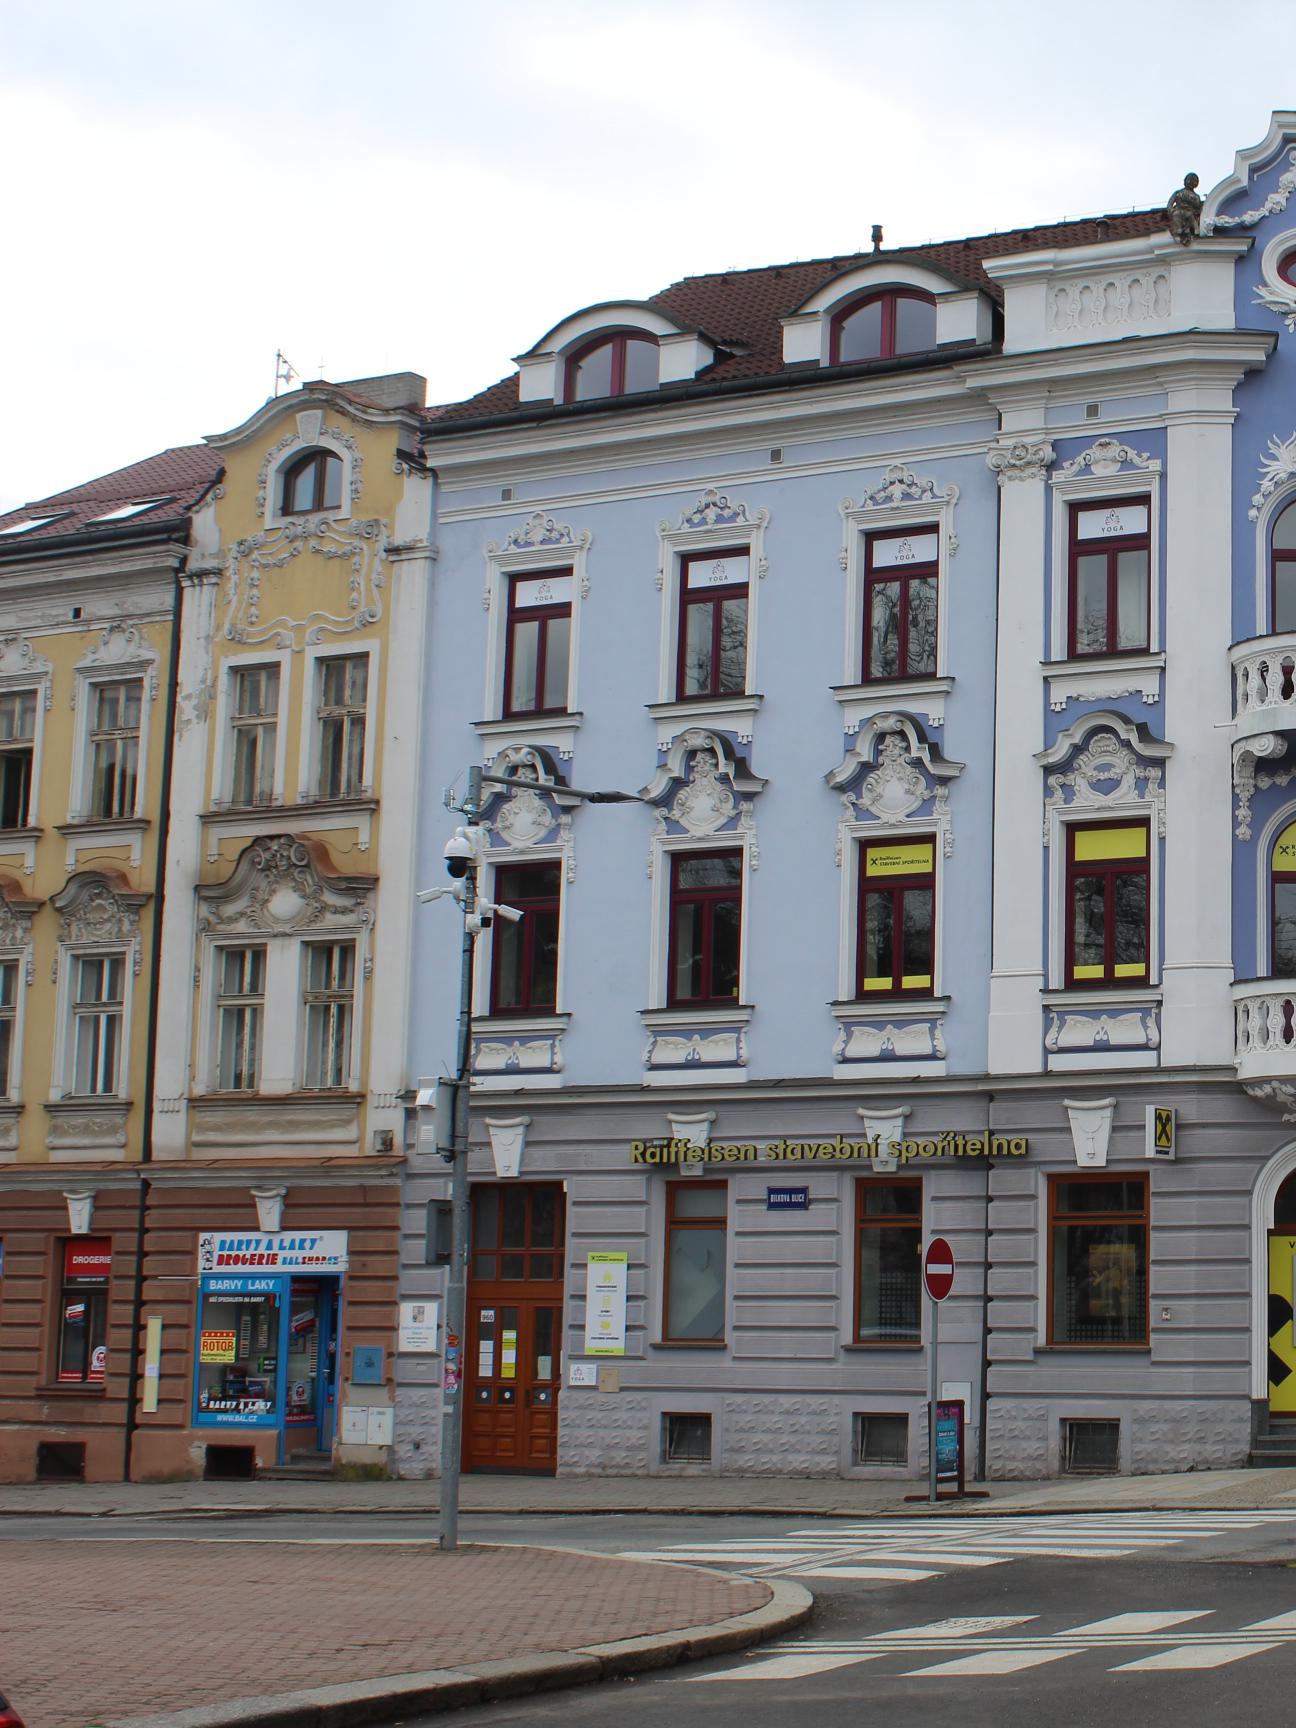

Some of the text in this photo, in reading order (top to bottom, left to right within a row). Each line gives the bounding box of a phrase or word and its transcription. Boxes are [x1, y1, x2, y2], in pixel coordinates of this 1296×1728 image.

[1101, 525, 1124, 533] YOGA
[894, 553, 916, 561] YOGA
[630, 1131, 1030, 1165] Raiffeisen stavební spořitelna
[218, 1237, 319, 1251] BARVY A LAKY
[72, 1255, 112, 1264] DROGERIE
[216, 1253, 279, 1266] DROGERIE
[209, 1279, 275, 1290] BARVY LAKY
[208, 1400, 236, 1409] BARVY
[216, 1414, 258, 1422] WWW.BAL.CZ
